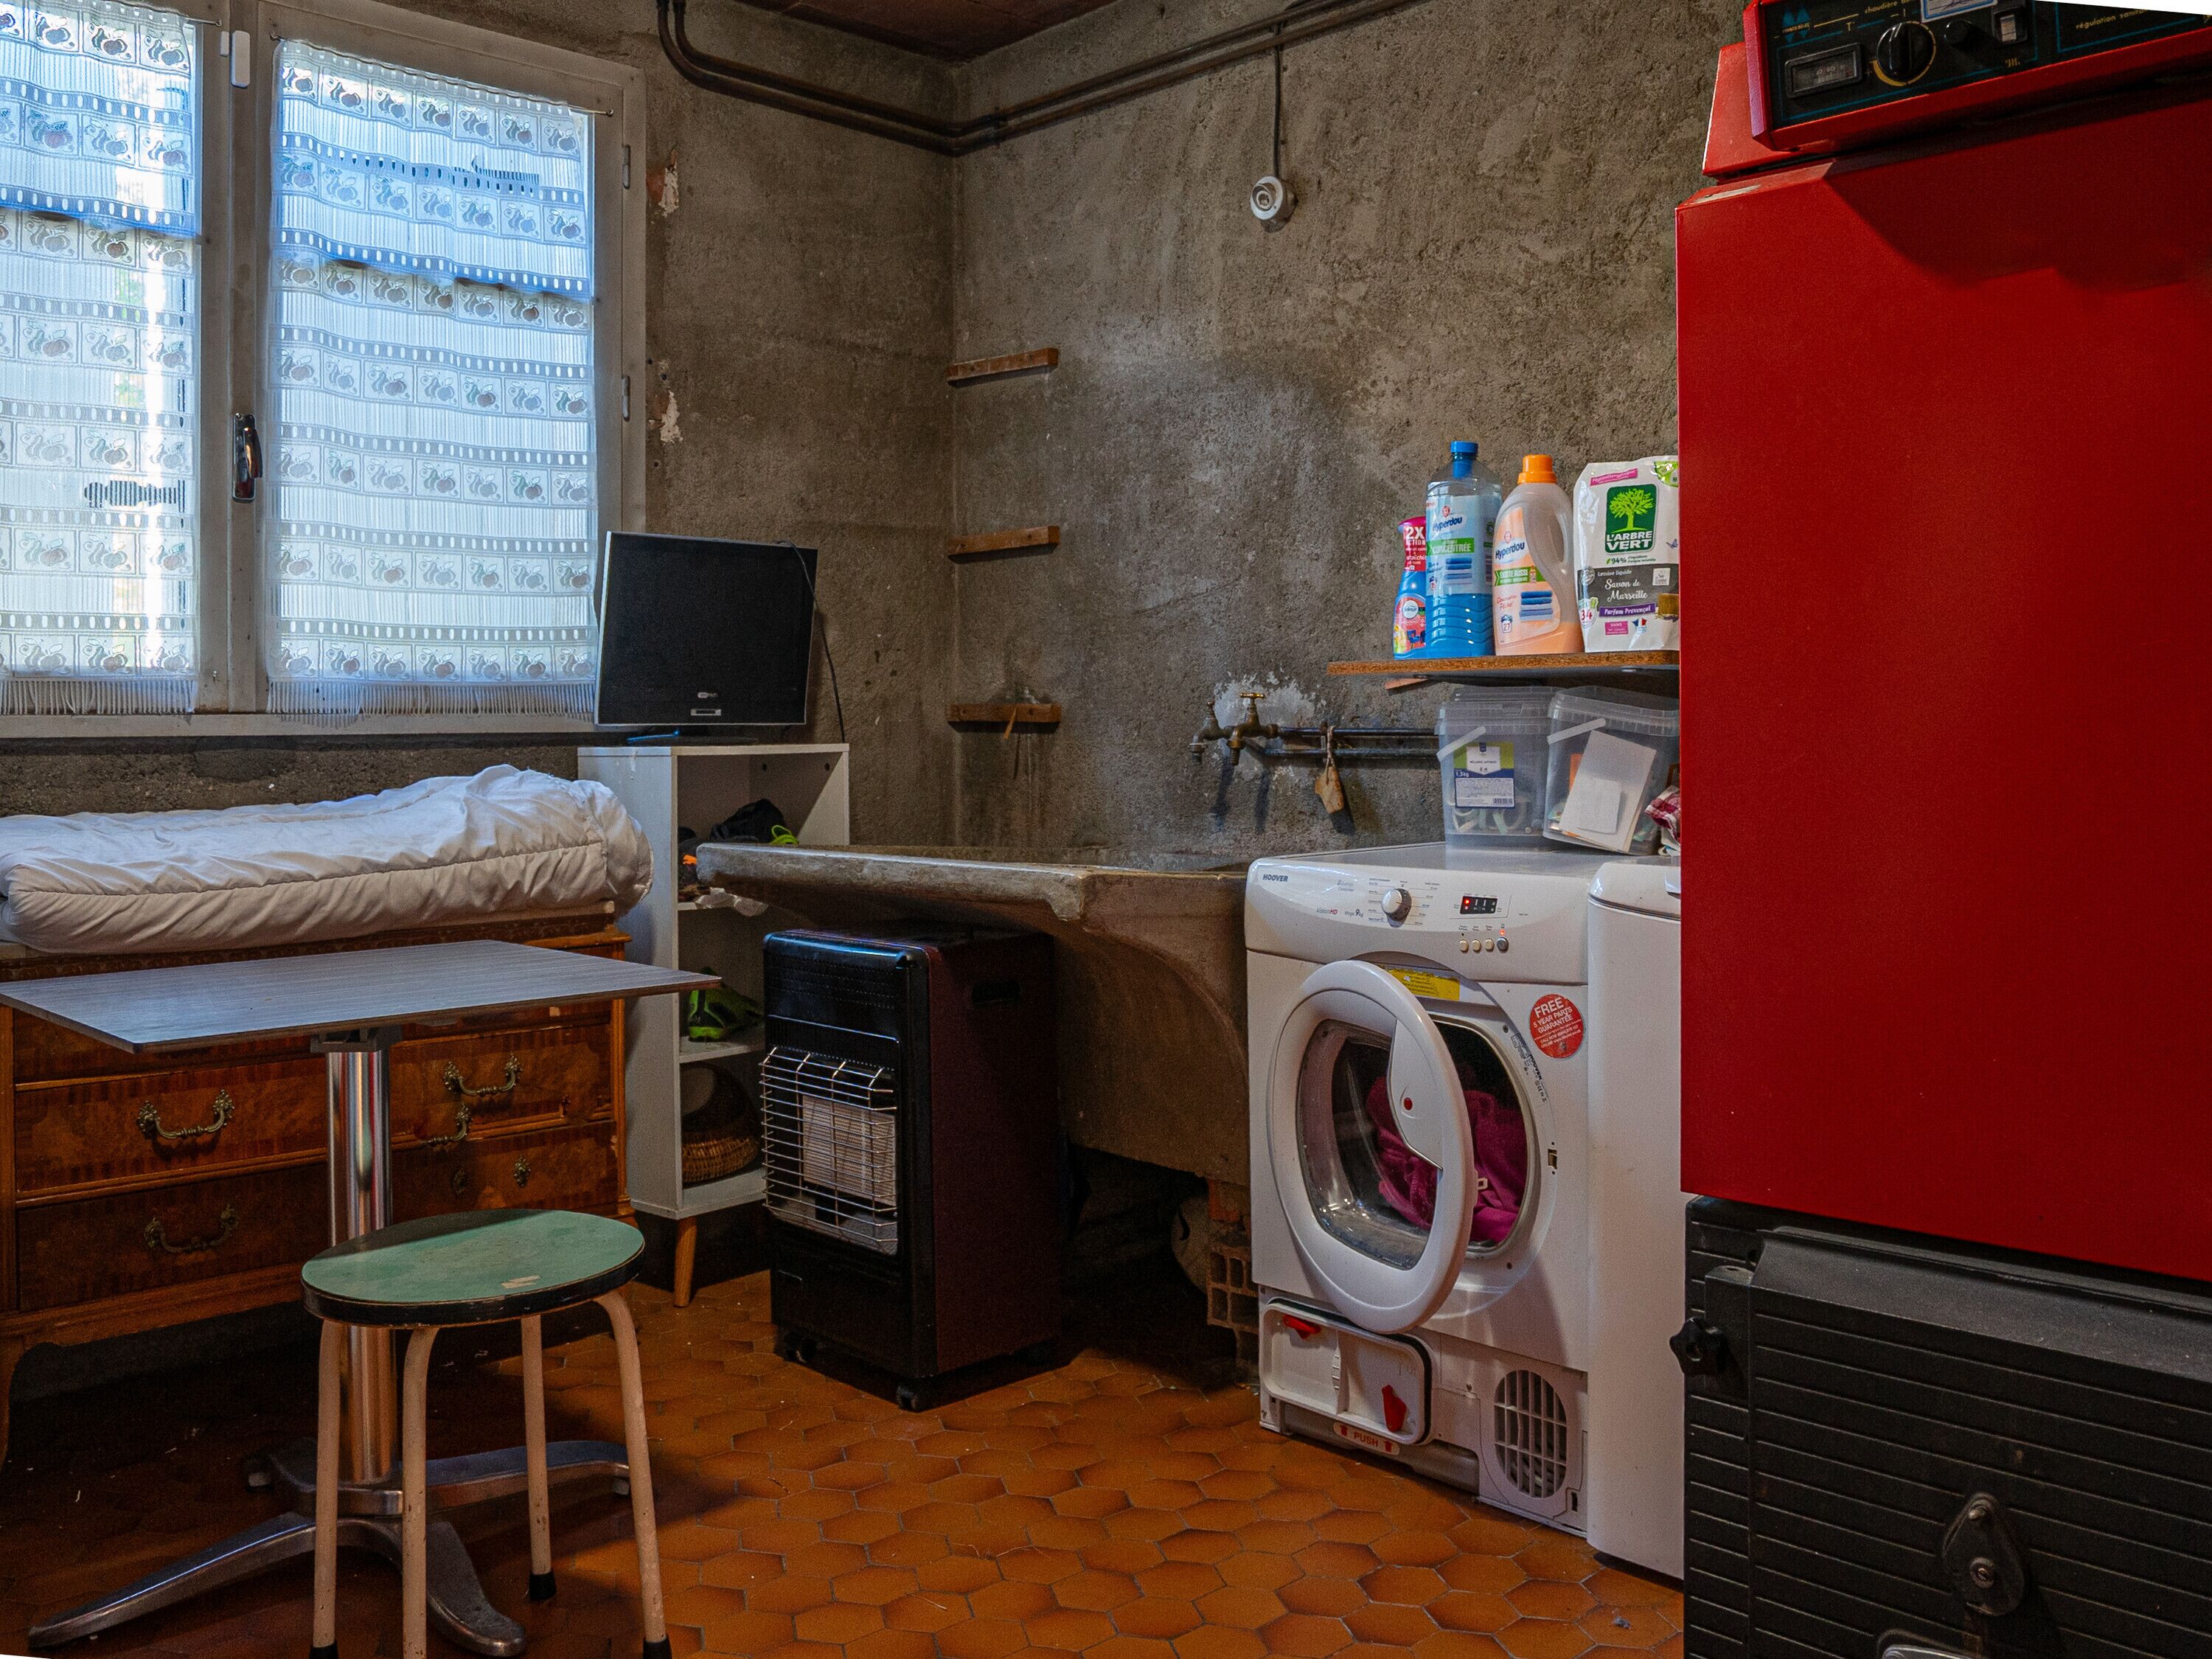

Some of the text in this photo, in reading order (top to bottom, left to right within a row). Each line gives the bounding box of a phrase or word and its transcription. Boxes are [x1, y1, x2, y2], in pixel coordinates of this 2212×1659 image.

[1864, 1, 1898, 13] chaudière
[2076, 15, 2116, 29] régulation
[1433, 516, 1463, 532] Hyperdou
[1405, 526, 1424, 539] 2X
[1607, 531, 1653, 542] L'ARBRE
[1495, 541, 1525, 560] Hyperdou
[1606, 539, 1652, 551] VERT
[1604, 579, 1641, 590] Savon de
[1607, 590, 1649, 602] Marseille
[1624, 605, 1651, 614] Provençal
[1503, 622, 1511, 631] 27
[1262, 874, 1289, 883] HOOVER
[1534, 997, 1564, 1018] FREE
[1537, 1015, 1554, 1026] YEAR
[1554, 1006, 1573, 1019] PARTS
[1538, 1014, 1573, 1034] GUARANTEE
[1354, 1431, 1379, 1447] PUSH
